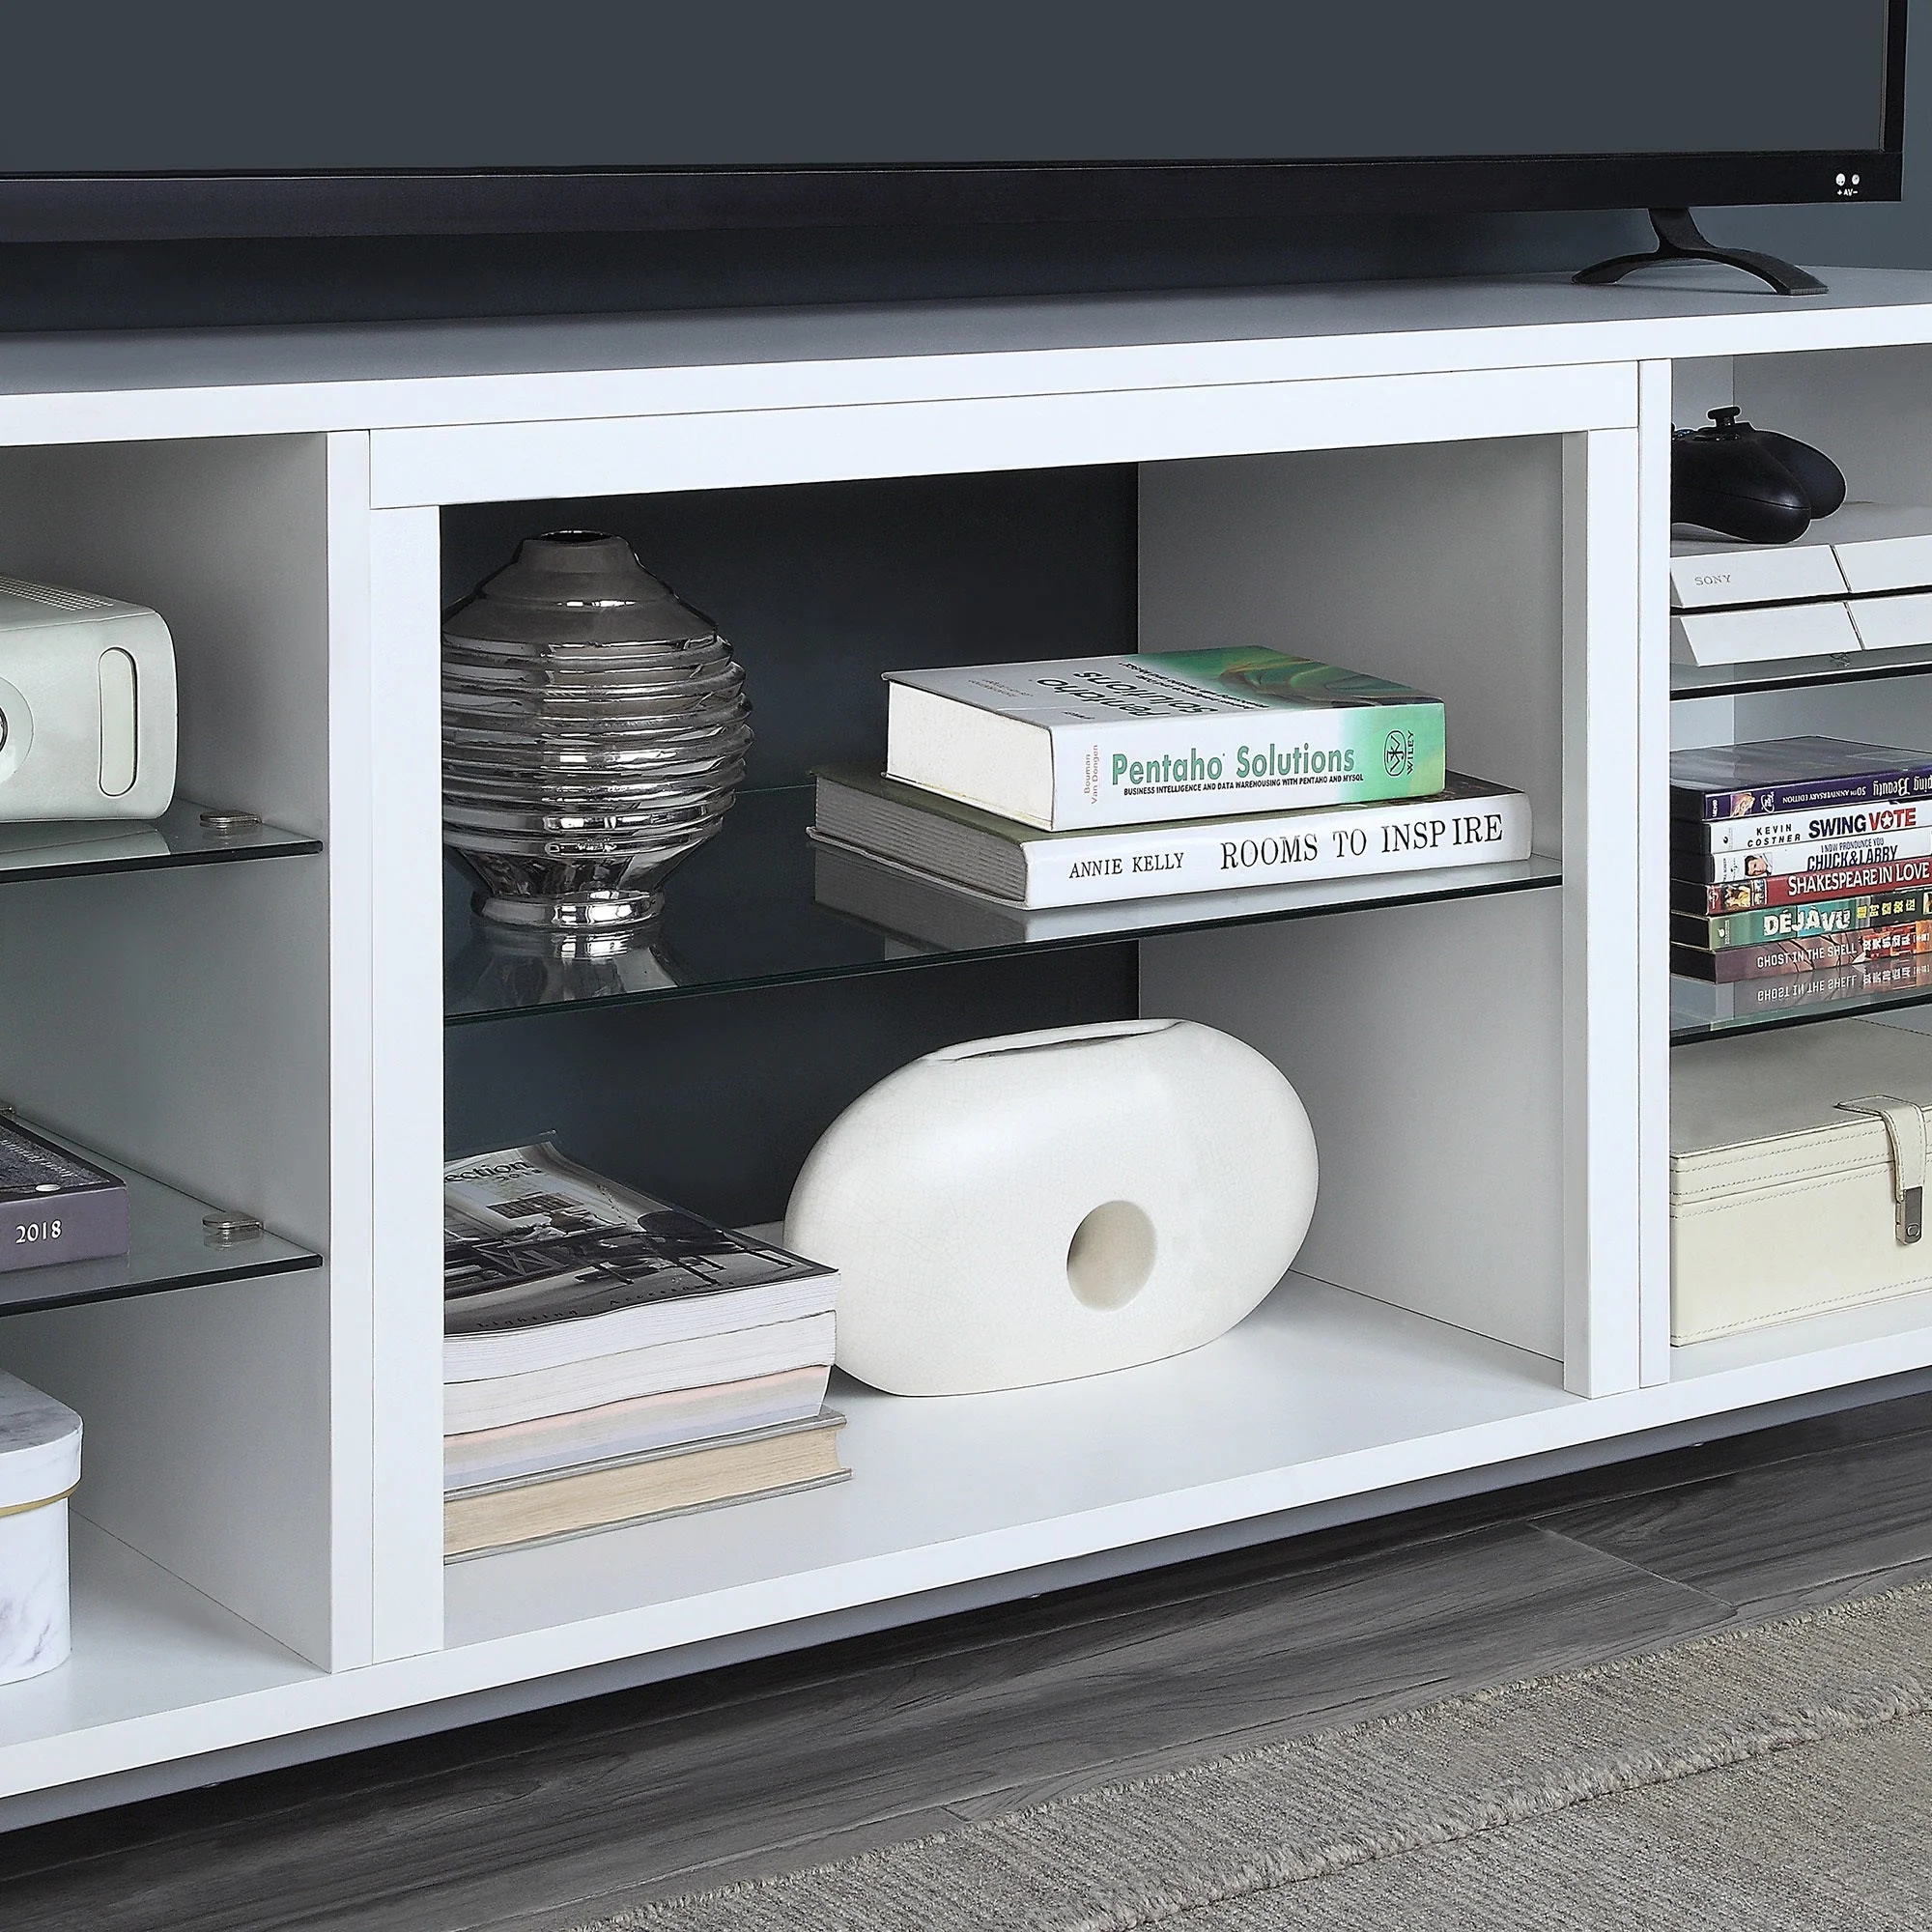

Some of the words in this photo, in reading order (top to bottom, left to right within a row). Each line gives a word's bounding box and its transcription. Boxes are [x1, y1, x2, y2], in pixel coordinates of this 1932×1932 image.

[1694, 574, 1732, 586] SONY
[1092, 744, 1100, 782] Dongen
[1112, 748, 1223, 785] Pentaho
[1236, 743, 1355, 778] Solutions
[1123, 786, 1155, 796] BUSINESS
[1156, 783, 1202, 794] INTELLIGENCE
[1203, 782, 1216, 791] AND
[1217, 781, 1235, 790] DATA
[1236, 779, 1281, 789] WAREHOUSING
[1282, 778, 1298, 786] WITH
[1298, 776, 1328, 785] PENTAHO
[1329, 775, 1342, 783] AND
[1343, 773, 1364, 782] MYSQL
[1809, 790, 1850, 801] ANNIVERSARY
[1873, 778, 1911, 797] Beauty
[1782, 795, 1808, 805] EDITION
[1756, 823, 1792, 837] KEVIN
[1808, 813, 1866, 838] SWING
[1868, 808, 1917, 832] VOTE
[1068, 858, 1123, 879] ANNIE
[1132, 851, 1184, 873] KELLY
[1219, 833, 1319, 870] ROOMS
[1332, 828, 1367, 859] TO
[1380, 813, 1504, 854] INSPIRE
[1747, 834, 1801, 848] COSTNER
[1824, 842, 1838, 853] NOW
[1839, 838, 1872, 851] PRONOUNCE
[1872, 837, 1885, 847] YOU
[1788, 867, 1878, 896] SHAKESPEARE
[1879, 866, 1893, 884] IN
[1895, 862, 1930, 882] LOVE
[1757, 952, 1791, 969] GHOST
[1792, 950, 1804, 963] IN
[1806, 947, 1826, 960] THE
[1827, 943, 1858, 957] SHELL
[15, 1219, 62, 1244] 2018
